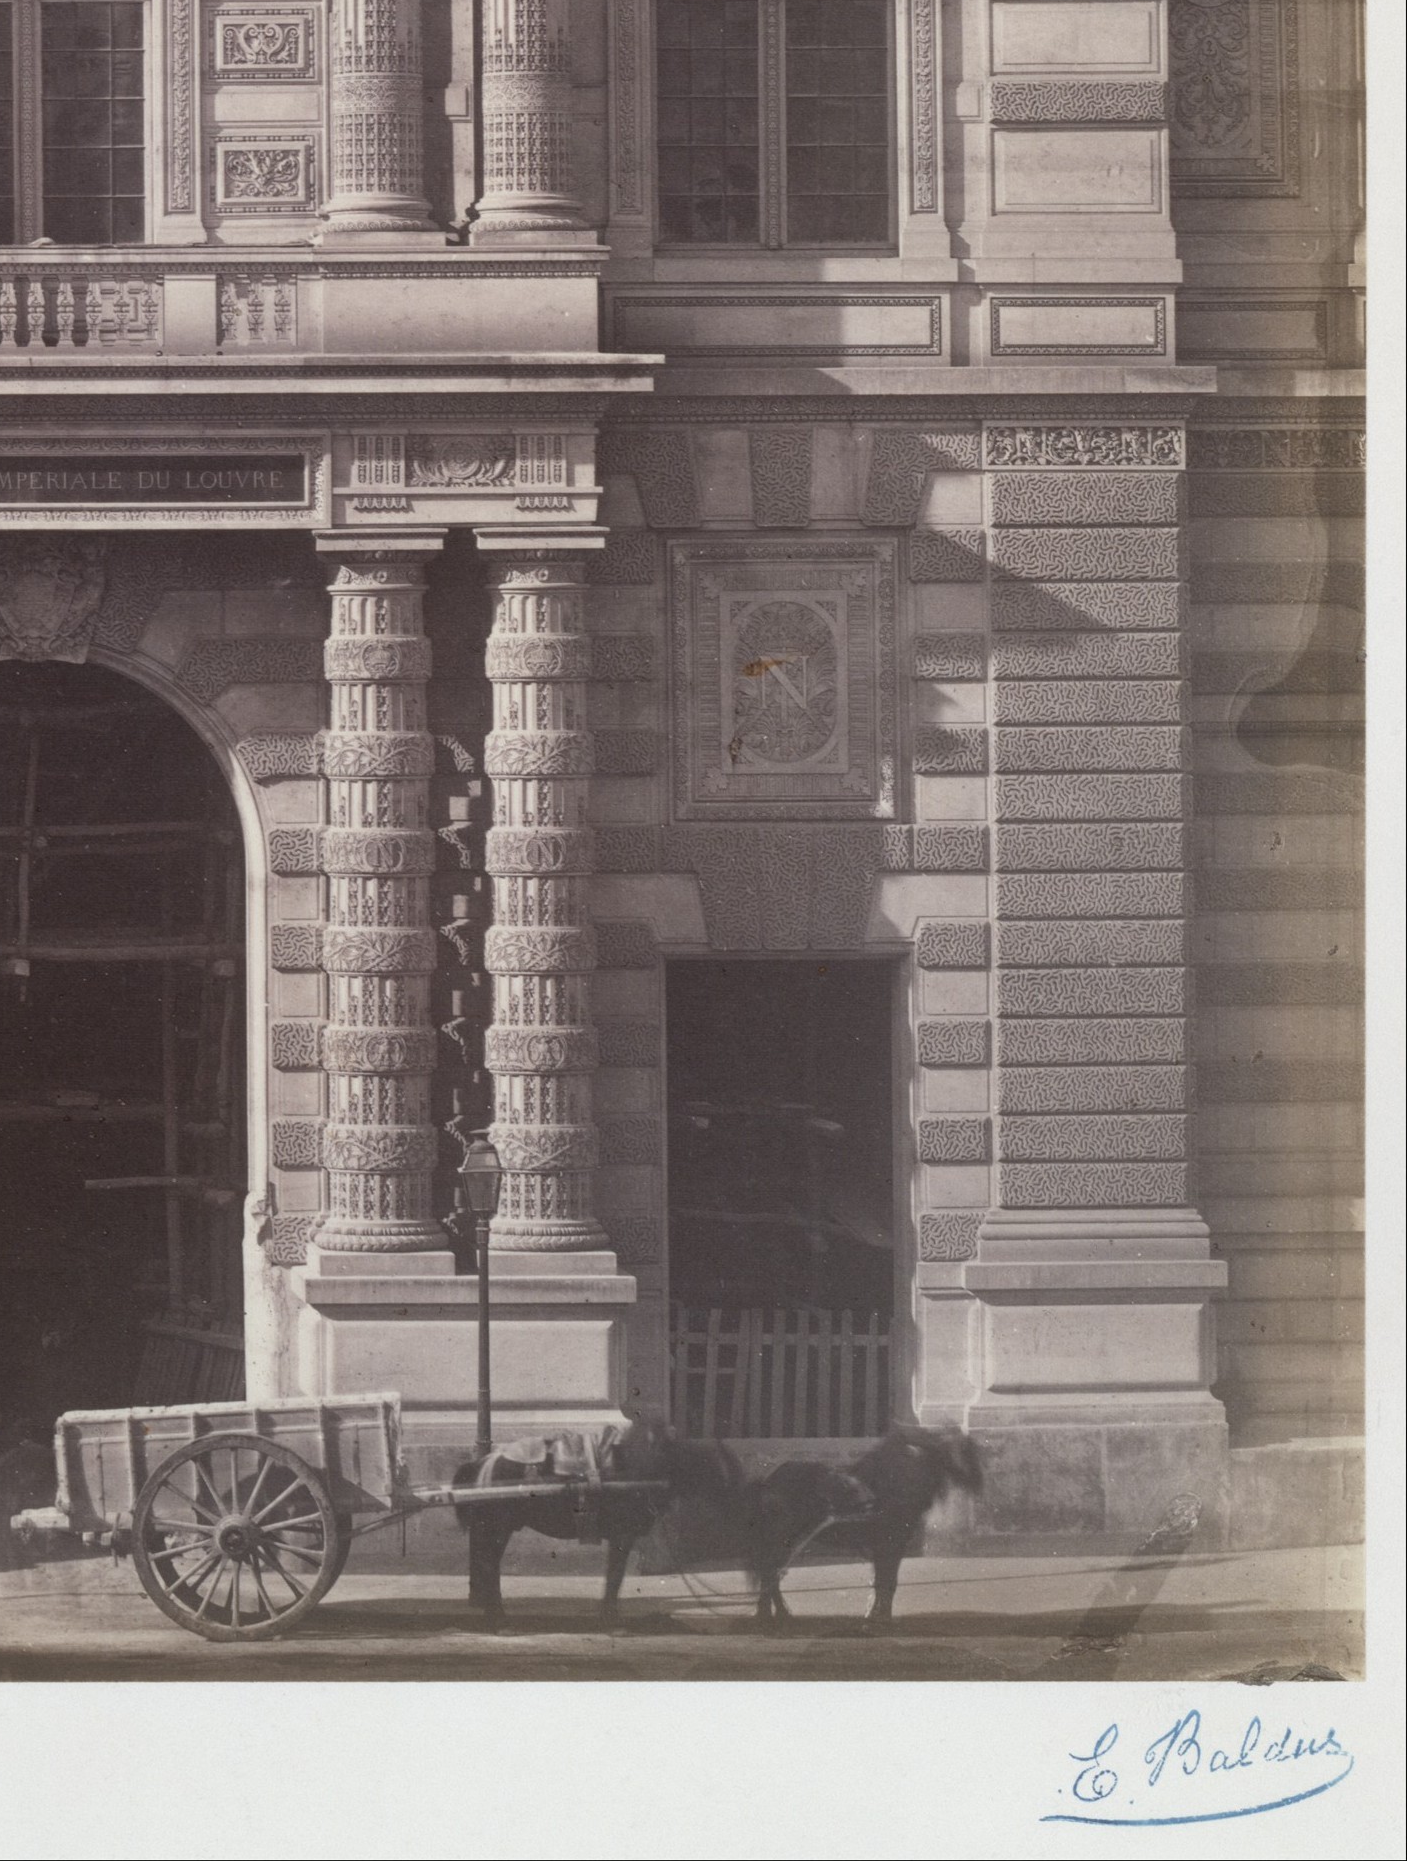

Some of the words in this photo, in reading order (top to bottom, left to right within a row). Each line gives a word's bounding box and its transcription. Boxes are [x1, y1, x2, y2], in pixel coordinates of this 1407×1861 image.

[138, 470, 170, 490] DU
[186, 470, 284, 490] LOUVRE
[1144, 1709, 1351, 1787] Baldus
